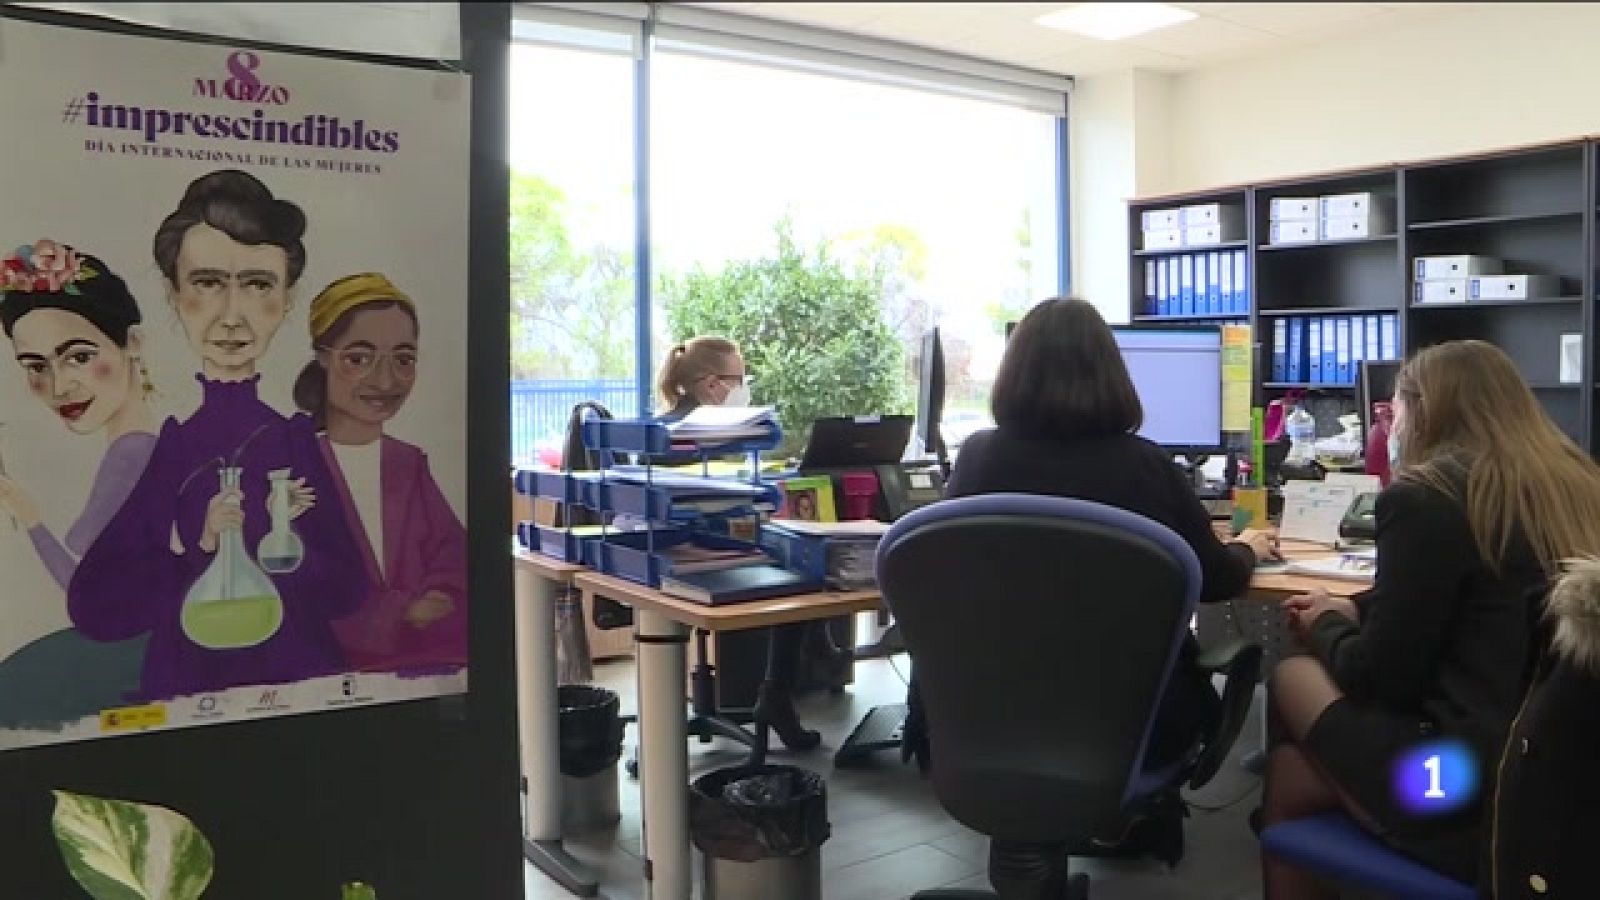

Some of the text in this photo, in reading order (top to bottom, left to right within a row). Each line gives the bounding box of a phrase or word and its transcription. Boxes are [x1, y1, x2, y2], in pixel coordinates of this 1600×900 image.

[194, 79, 289, 105] MARZO
[225, 51, 261, 101] 8
[62, 92, 399, 153] #imprescindibles
[121, 143, 253, 164] INTERNACIONAL
[259, 154, 277, 166] DE
[284, 156, 312, 168] LAS
[316, 159, 381, 174] MUJERES
